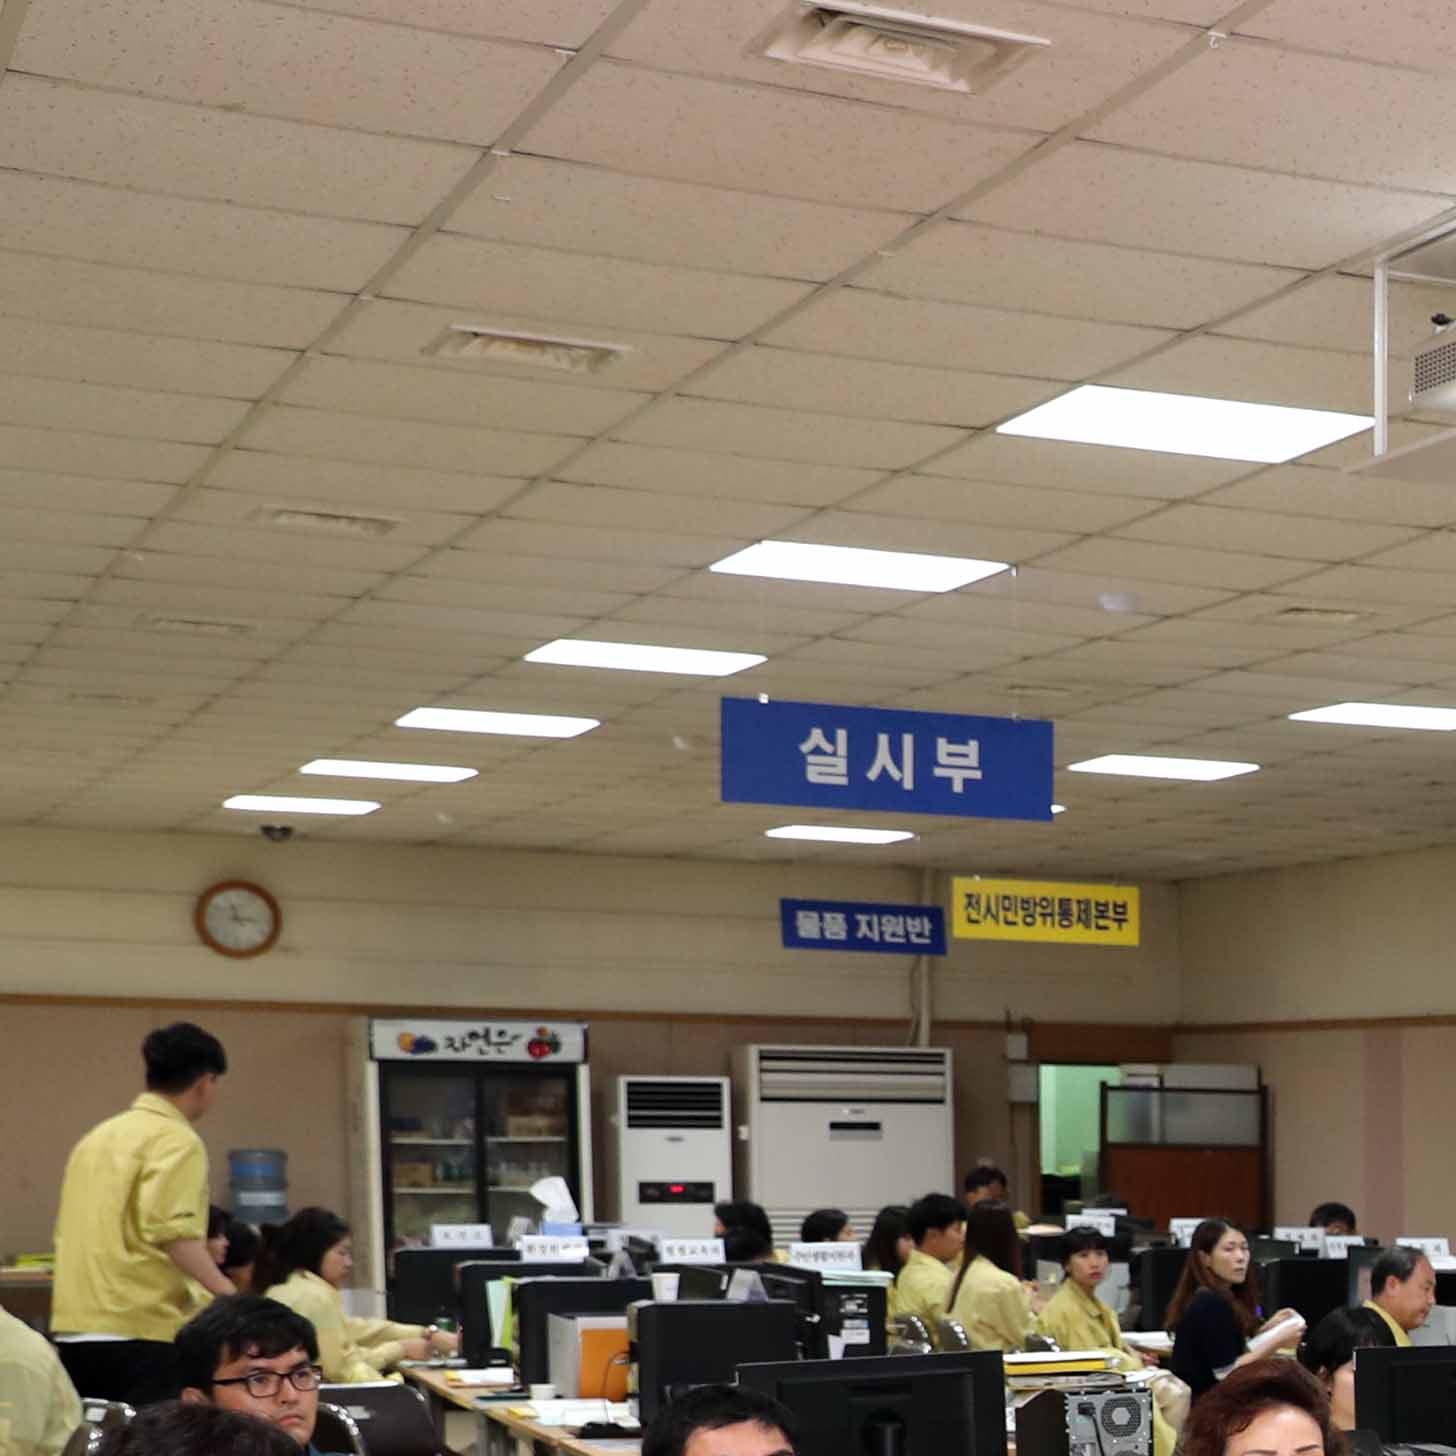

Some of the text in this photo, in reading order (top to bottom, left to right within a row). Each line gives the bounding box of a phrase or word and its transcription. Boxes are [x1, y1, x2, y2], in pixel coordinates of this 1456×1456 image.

[799, 727, 984, 793] 실시부
[854, 913, 932, 944] 지원반
[964, 892, 1129, 932] 전시민방위통제본부
